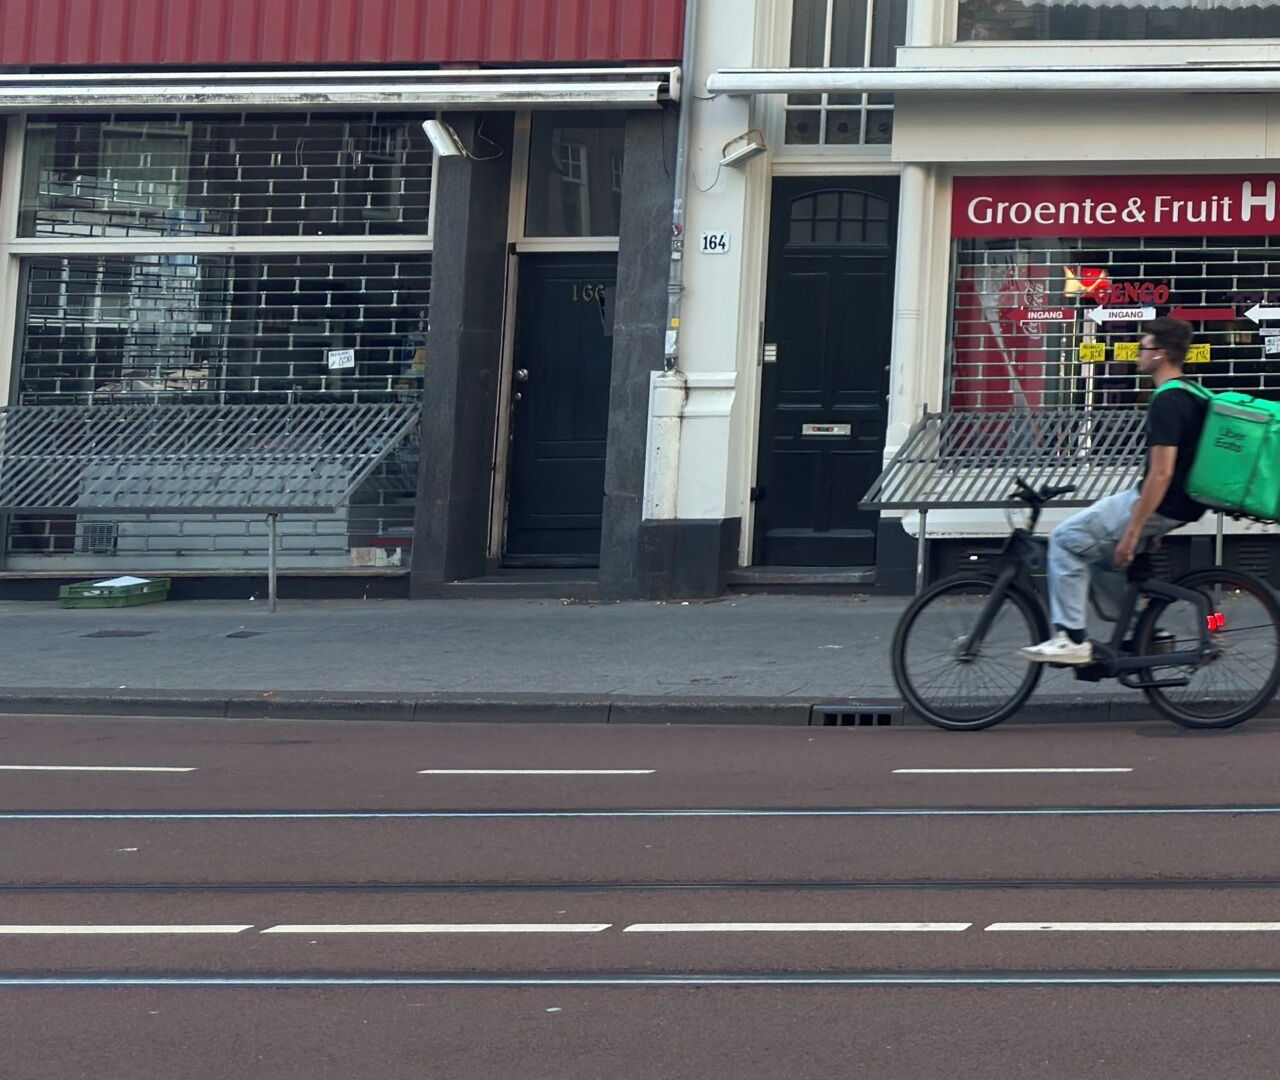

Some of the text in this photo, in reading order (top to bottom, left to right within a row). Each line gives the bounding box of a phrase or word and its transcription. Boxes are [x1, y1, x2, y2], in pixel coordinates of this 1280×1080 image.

[967, 196, 1118, 224] Groente
[1121, 196, 1146, 223] &
[1154, 195, 1233, 222] Fruit
[703, 234, 726, 250] 164
[1028, 311, 1063, 319] INGANG
